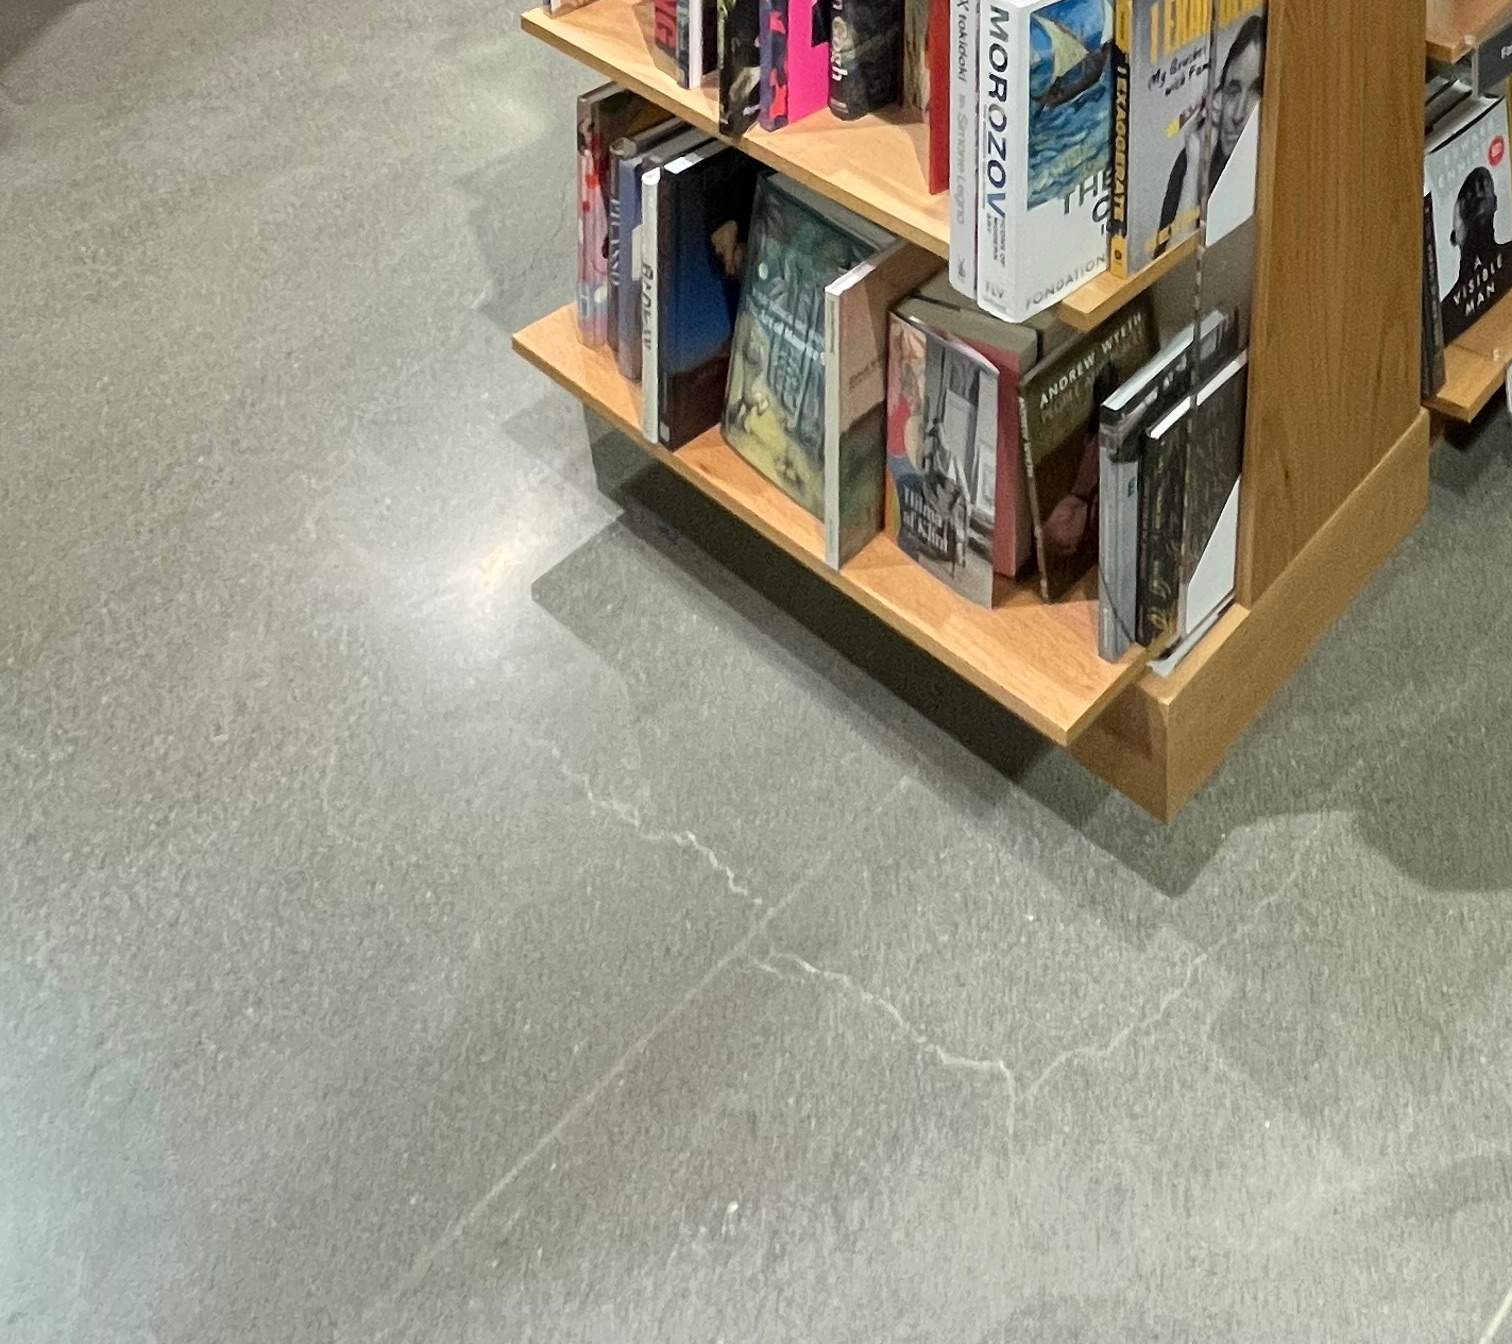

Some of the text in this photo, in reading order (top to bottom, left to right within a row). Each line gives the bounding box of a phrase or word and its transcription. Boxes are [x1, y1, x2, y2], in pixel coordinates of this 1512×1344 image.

[830, 15, 849, 82] Gogh
[957, 13, 969, 83] tokidoki
[985, 5, 1011, 219] MOROZOV
[1112, 77, 1128, 222] EXAGGERATE
[1452, 252, 1504, 306] VISIBLE
[1464, 282, 1496, 317] MAN
[1039, 351, 1096, 410] ANDREW
